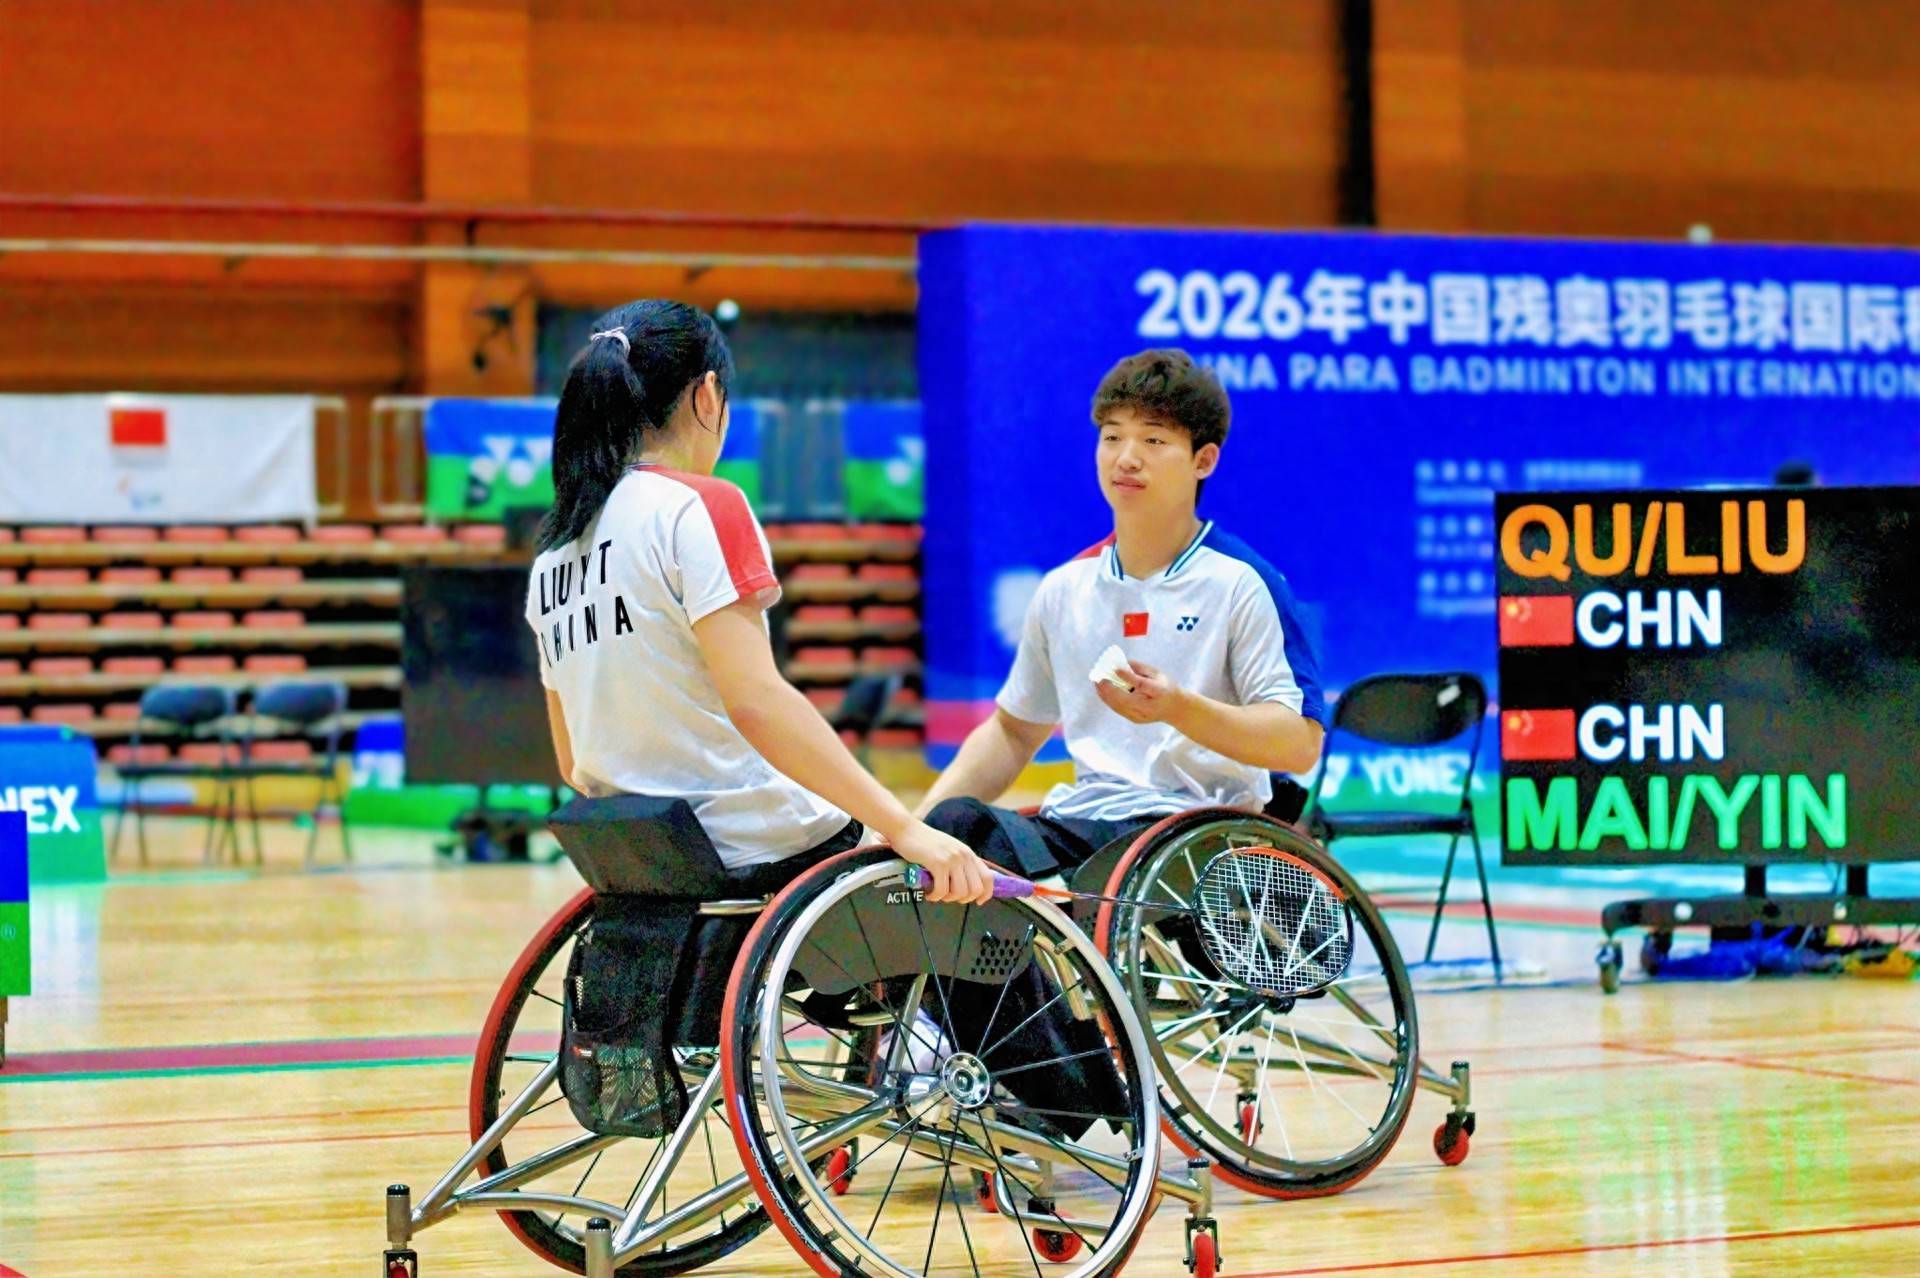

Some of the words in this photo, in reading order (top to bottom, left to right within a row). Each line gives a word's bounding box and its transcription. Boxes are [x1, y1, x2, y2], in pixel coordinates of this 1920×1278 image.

[1137, 269, 1920, 352] 2026年中国残奥羽毛球国际
[1288, 353, 1398, 391] PARA
[1410, 356, 1655, 396] BADMINTON
[540, 562, 573, 616] LIU
[599, 539, 612, 584] T
[1500, 499, 1806, 581] QU/LIU
[1576, 589, 1722, 646] CHN
[1578, 704, 1724, 761] CHN
[1506, 774, 1846, 850] MAI/YIN
